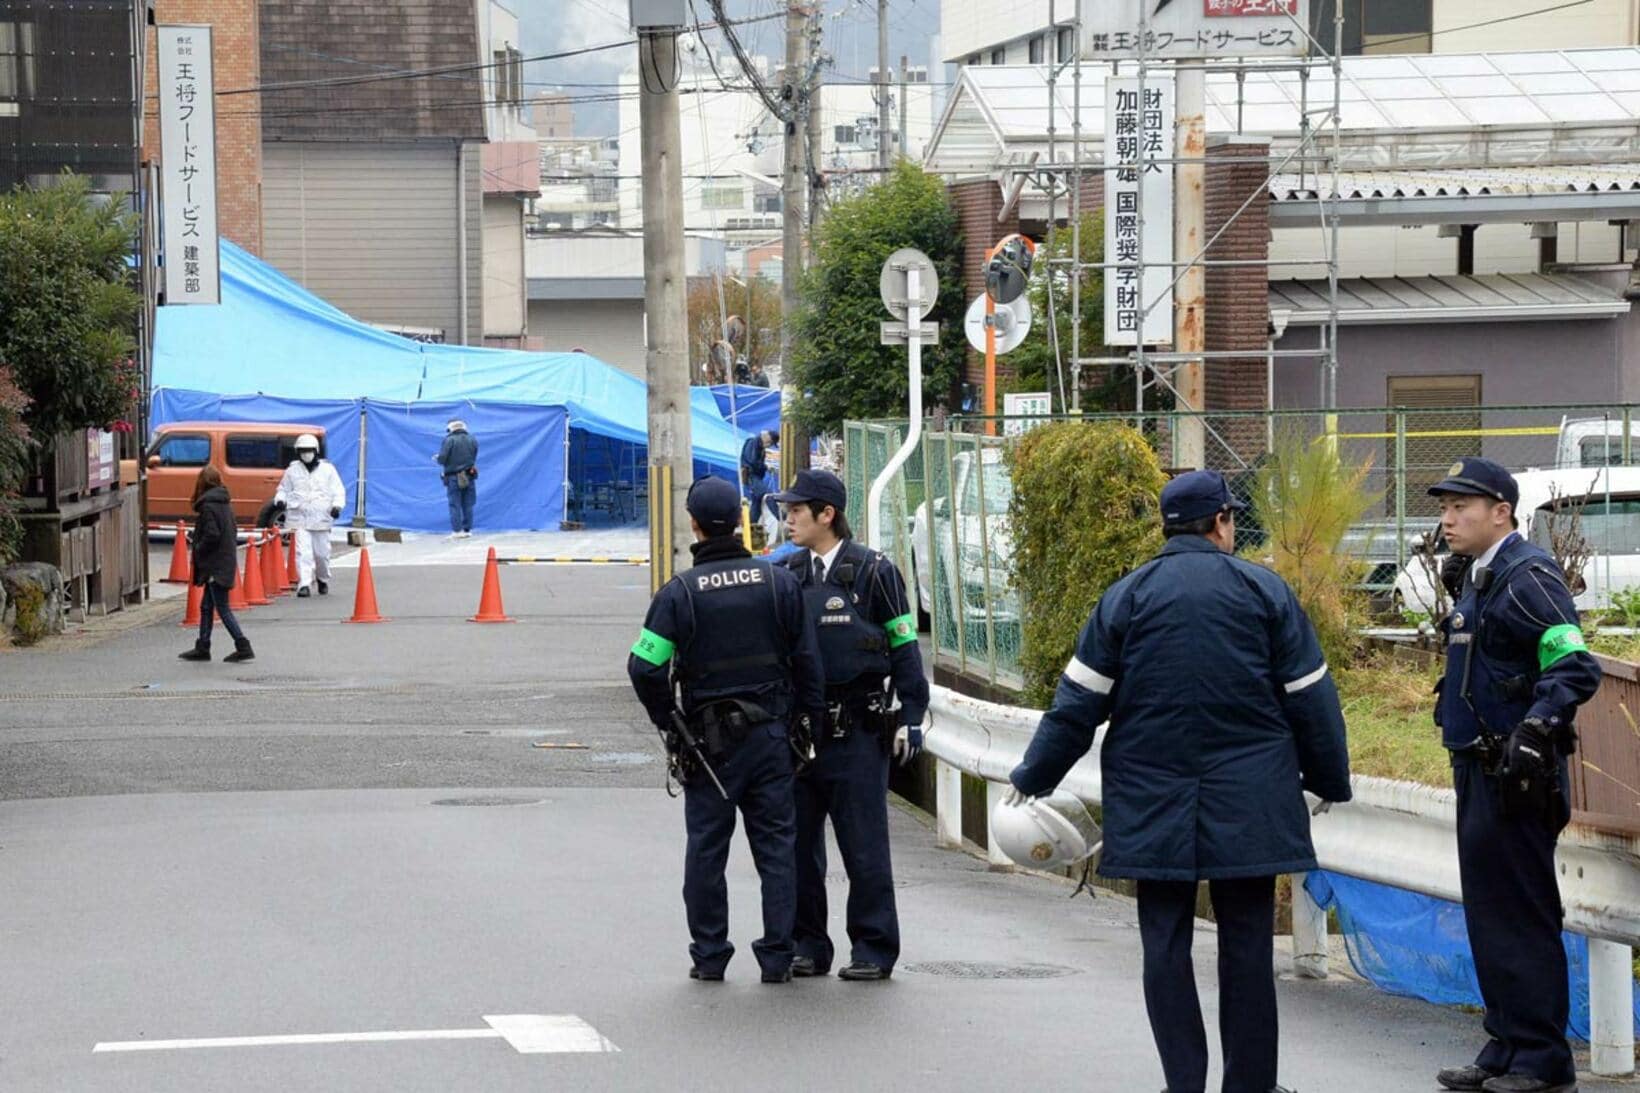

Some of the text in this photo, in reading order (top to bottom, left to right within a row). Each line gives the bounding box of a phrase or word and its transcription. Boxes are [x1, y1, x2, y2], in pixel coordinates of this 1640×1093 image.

[175, 63, 200, 237] 王将フードサービス
[183, 245, 200, 293] 建築部
[698, 568, 762, 590] POLICE
